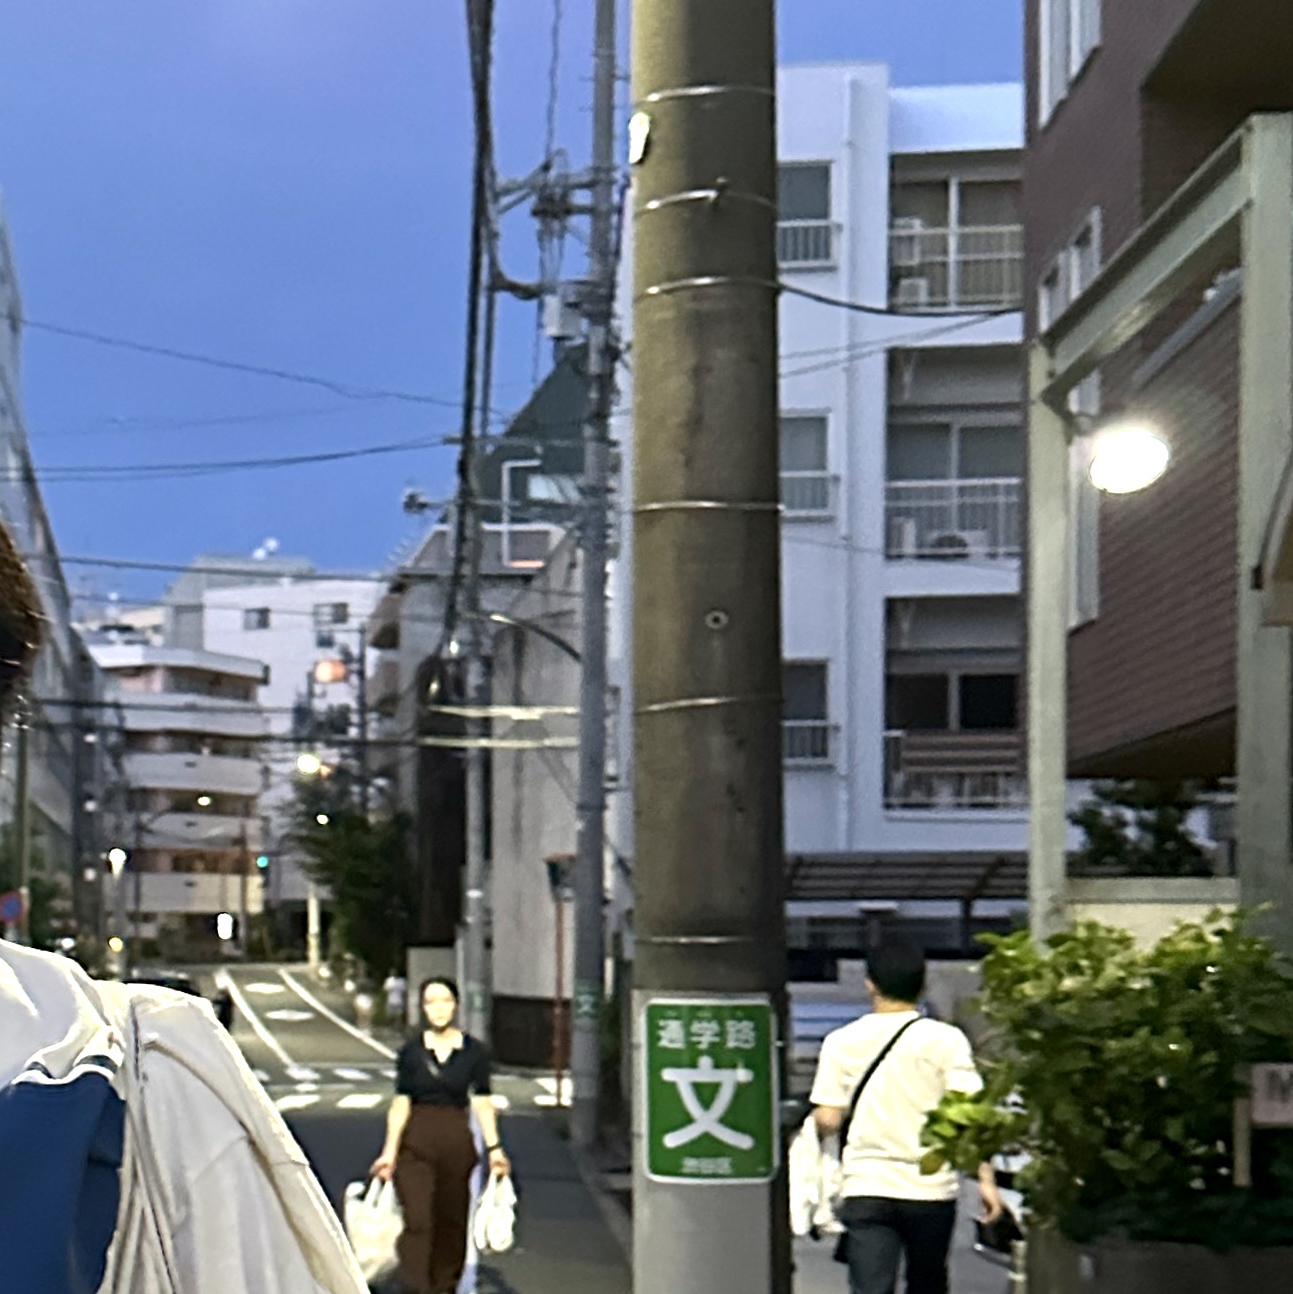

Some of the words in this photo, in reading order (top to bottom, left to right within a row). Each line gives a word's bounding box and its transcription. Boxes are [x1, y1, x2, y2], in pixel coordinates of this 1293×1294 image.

[658, 1019, 756, 1049] 通学路
[661, 1056, 754, 1150] 文
